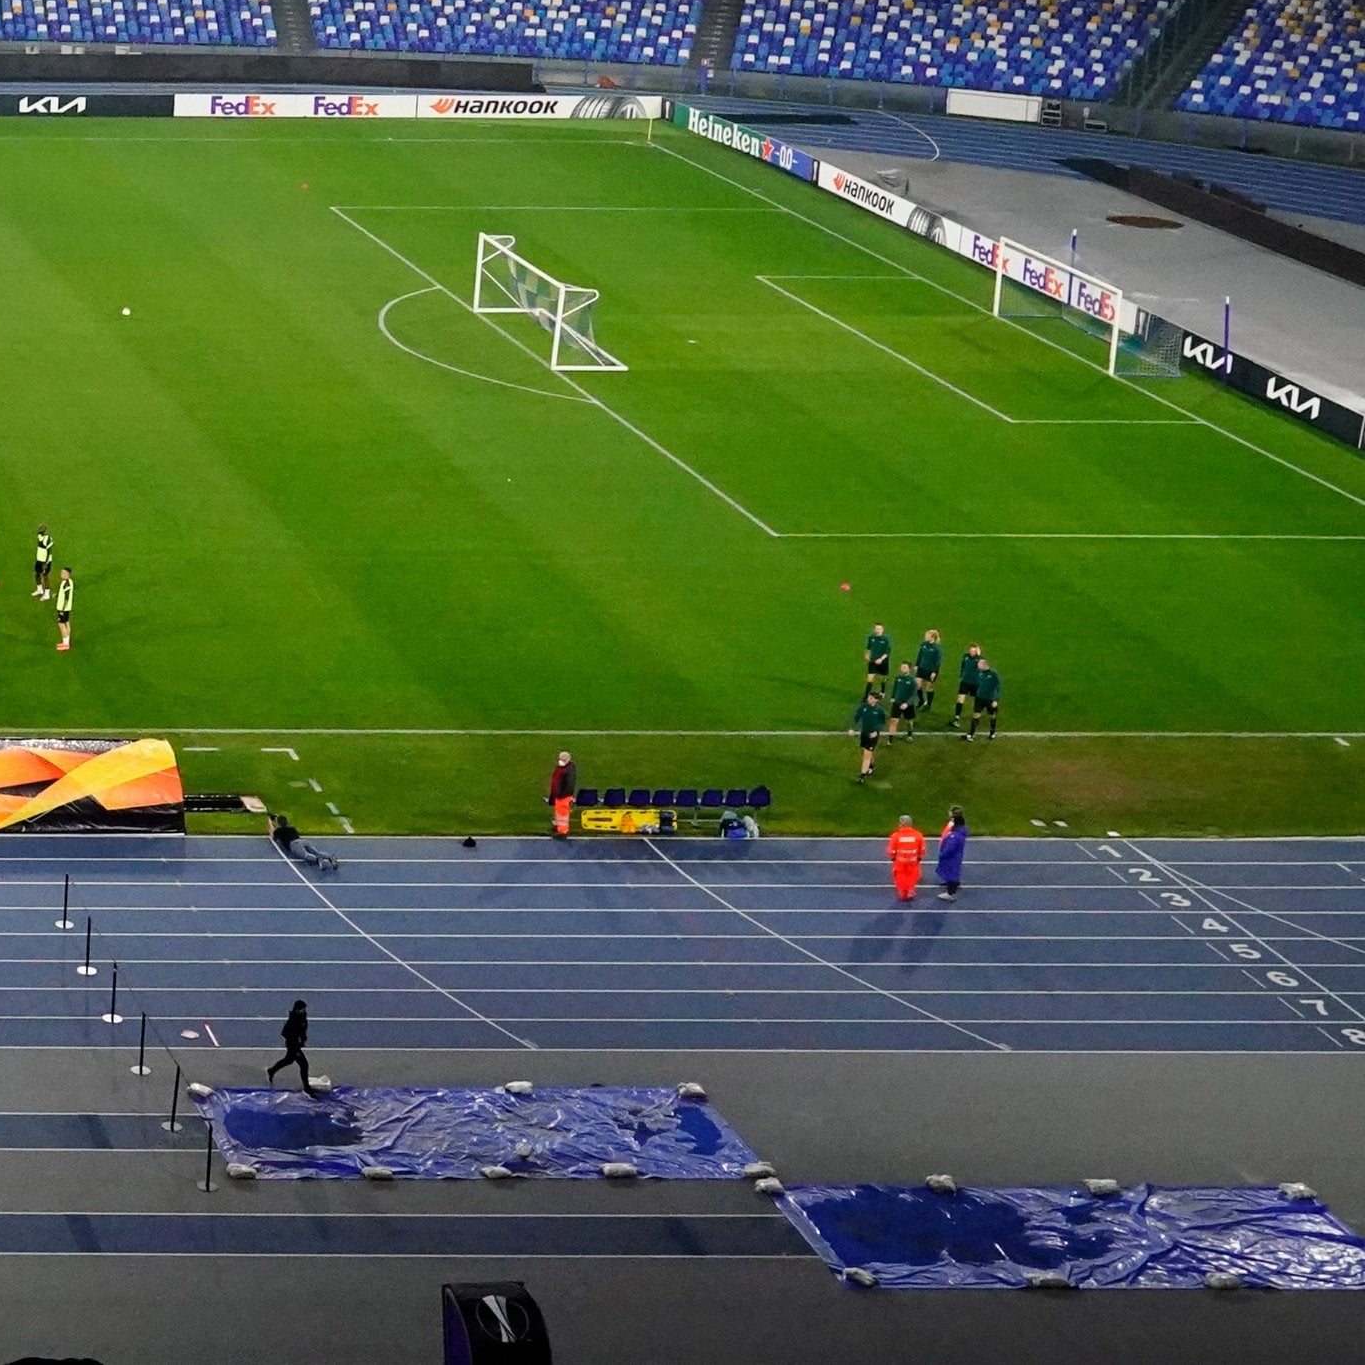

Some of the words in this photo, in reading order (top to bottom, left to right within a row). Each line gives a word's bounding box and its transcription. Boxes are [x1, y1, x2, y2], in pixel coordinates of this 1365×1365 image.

[210, 95, 276, 116] FedEx
[314, 95, 380, 116] FedEx
[688, 107, 761, 158] Heineken
[1022, 257, 1065, 298] FedEx
[1097, 844, 1122, 858] 1
[1128, 867, 1162, 882] 2
[1160, 892, 1192, 907] 3
[1201, 917, 1229, 933] 4
[1229, 943, 1261, 960] 5
[1266, 970, 1299, 987] 6
[1299, 998, 1329, 1016] 7
